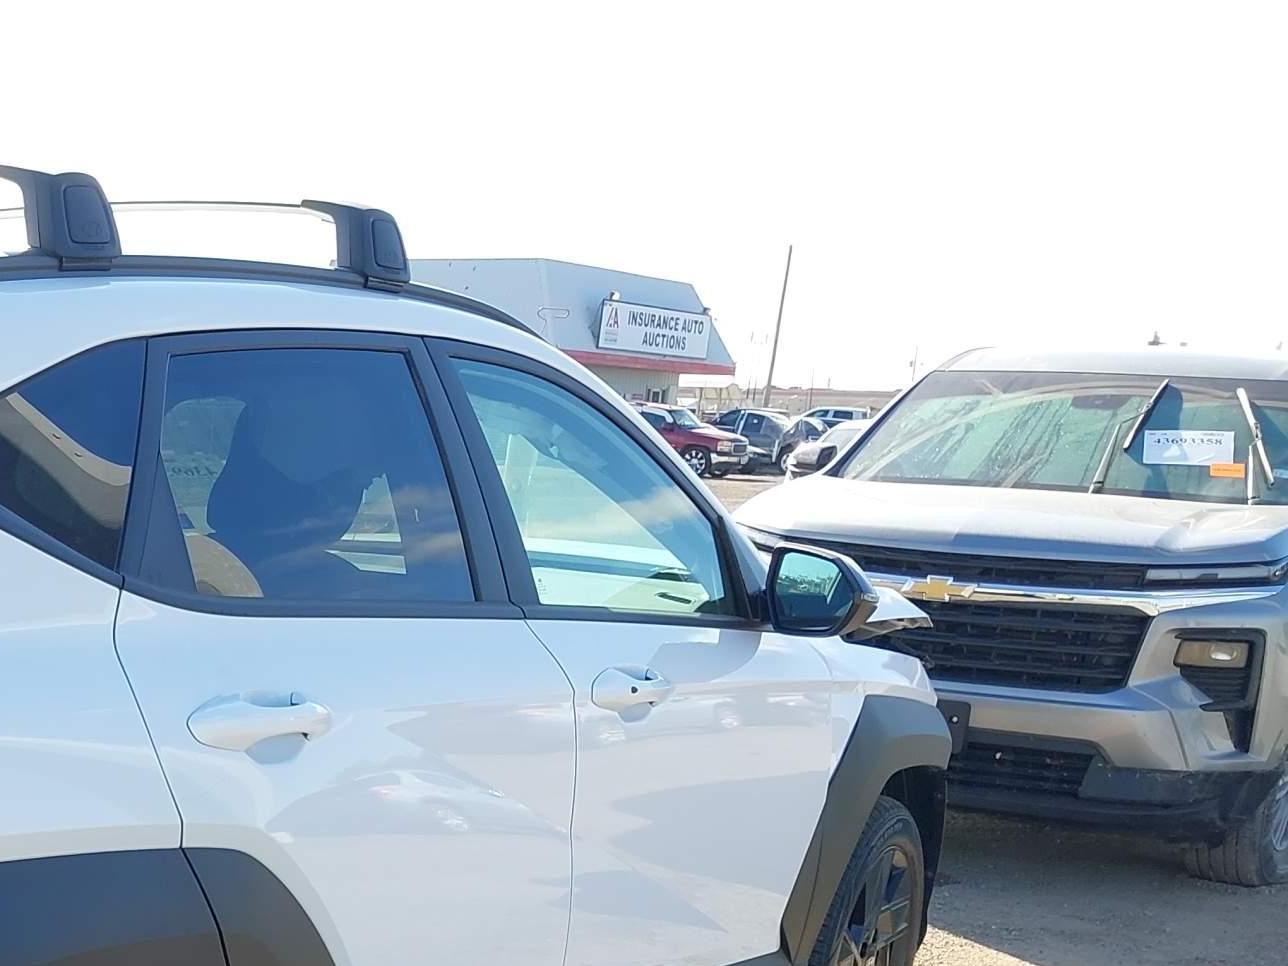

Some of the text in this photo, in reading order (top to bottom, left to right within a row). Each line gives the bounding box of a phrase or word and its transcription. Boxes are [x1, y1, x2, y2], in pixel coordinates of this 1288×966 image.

[627, 311, 704, 335] INSURANCE AUTO
[642, 331, 687, 351] AUCTIONS
